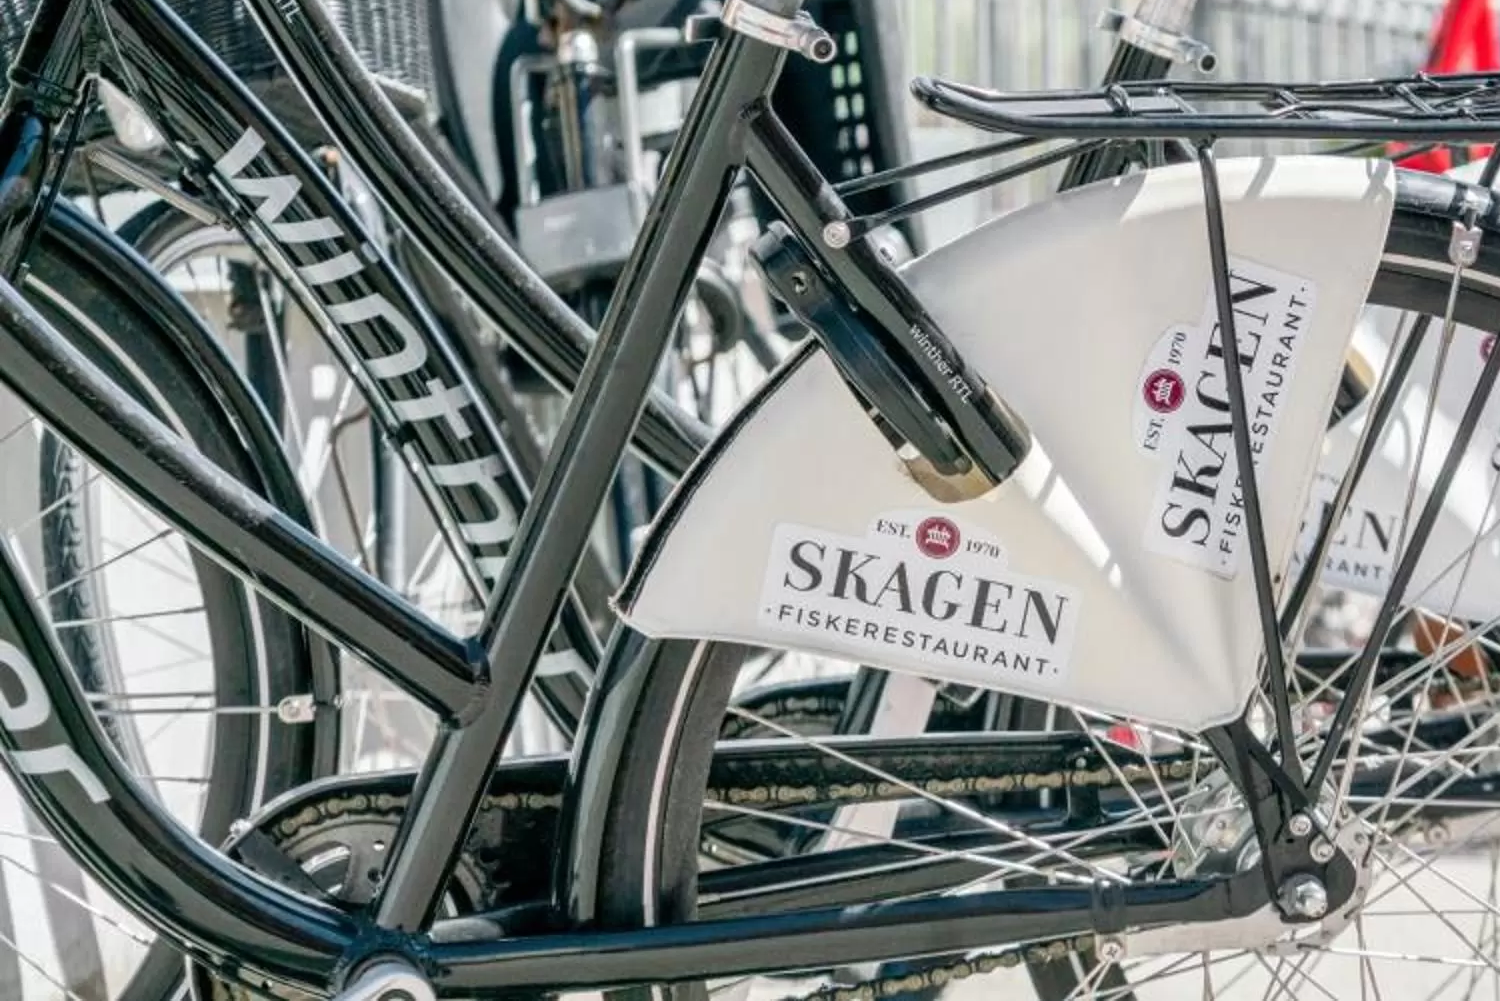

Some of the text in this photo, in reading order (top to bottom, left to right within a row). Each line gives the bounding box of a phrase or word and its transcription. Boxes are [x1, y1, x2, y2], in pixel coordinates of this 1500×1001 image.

[909, 323, 973, 404] winther RTL
[1143, 331, 1186, 450] EST. 1970
[876, 518, 1000, 559] EST. 1970
[783, 539, 1069, 646] SKAGEN
[777, 603, 1052, 676] FISKERESTAURANT
